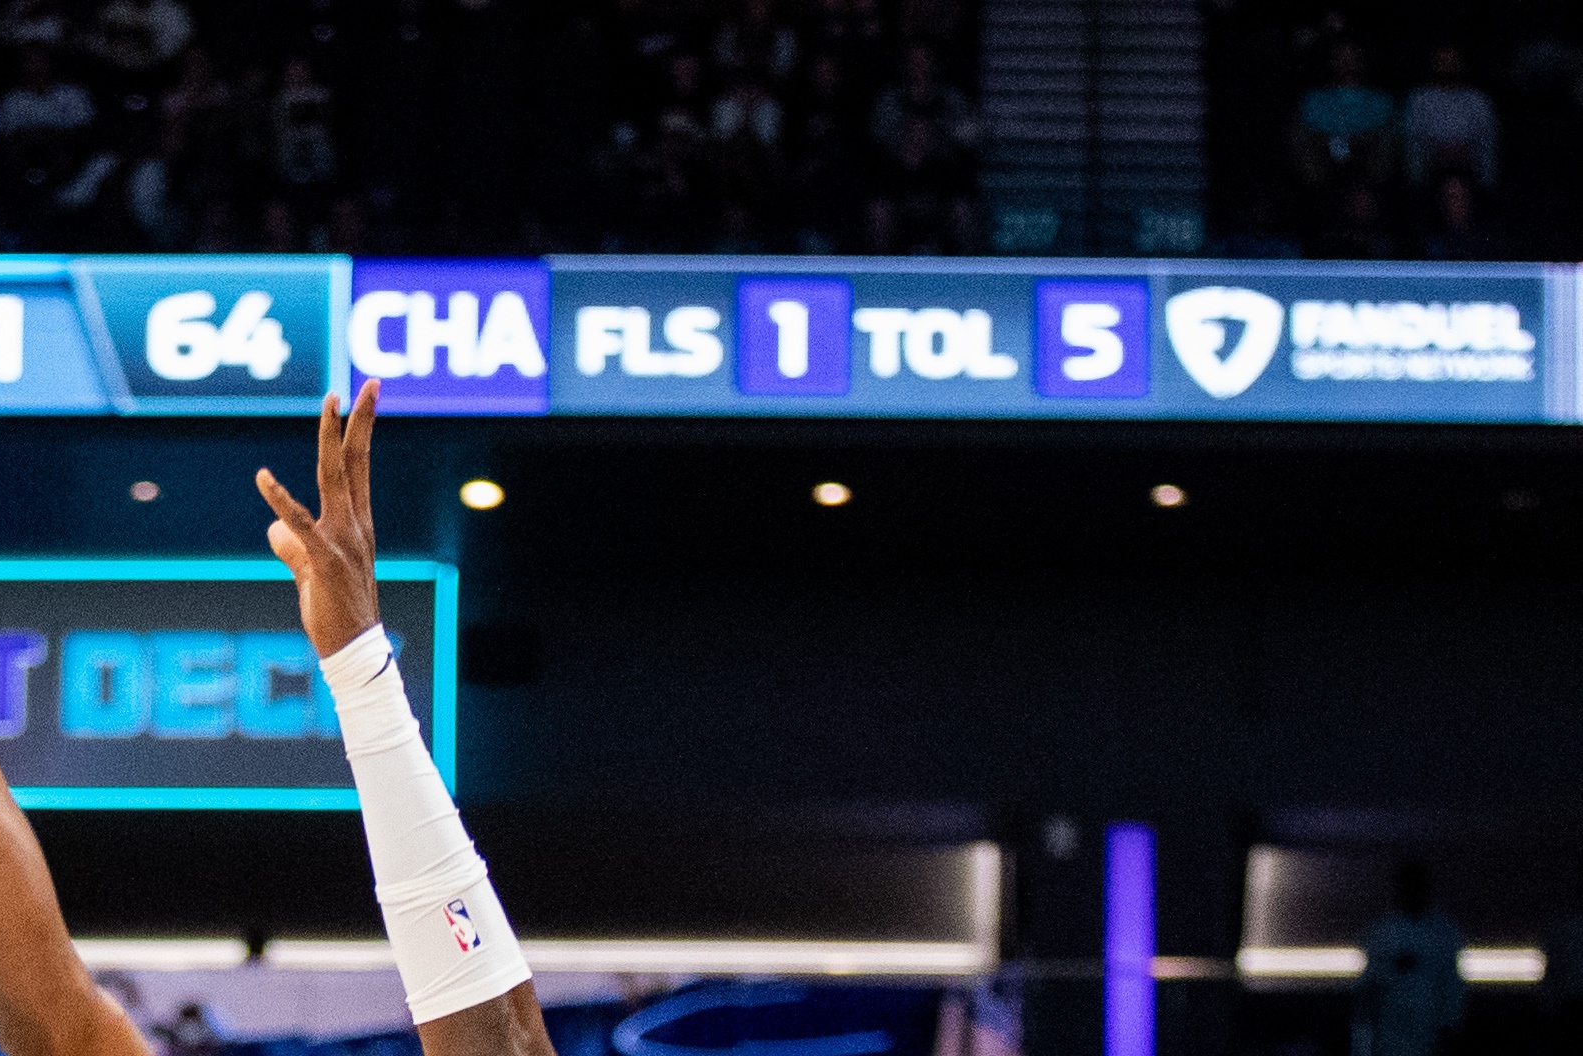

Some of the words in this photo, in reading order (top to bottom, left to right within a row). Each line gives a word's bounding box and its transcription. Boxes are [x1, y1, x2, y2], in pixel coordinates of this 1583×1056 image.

[145, 289, 292, 381] 64
[348, 289, 546, 380] CHA
[575, 305, 725, 378] FLS
[767, 299, 810, 379] 1
[853, 307, 1019, 380] TOL
[1060, 302, 1125, 382] 5
[1290, 300, 1536, 352] FANDUEL
[59, 630, 401, 739] DEC
